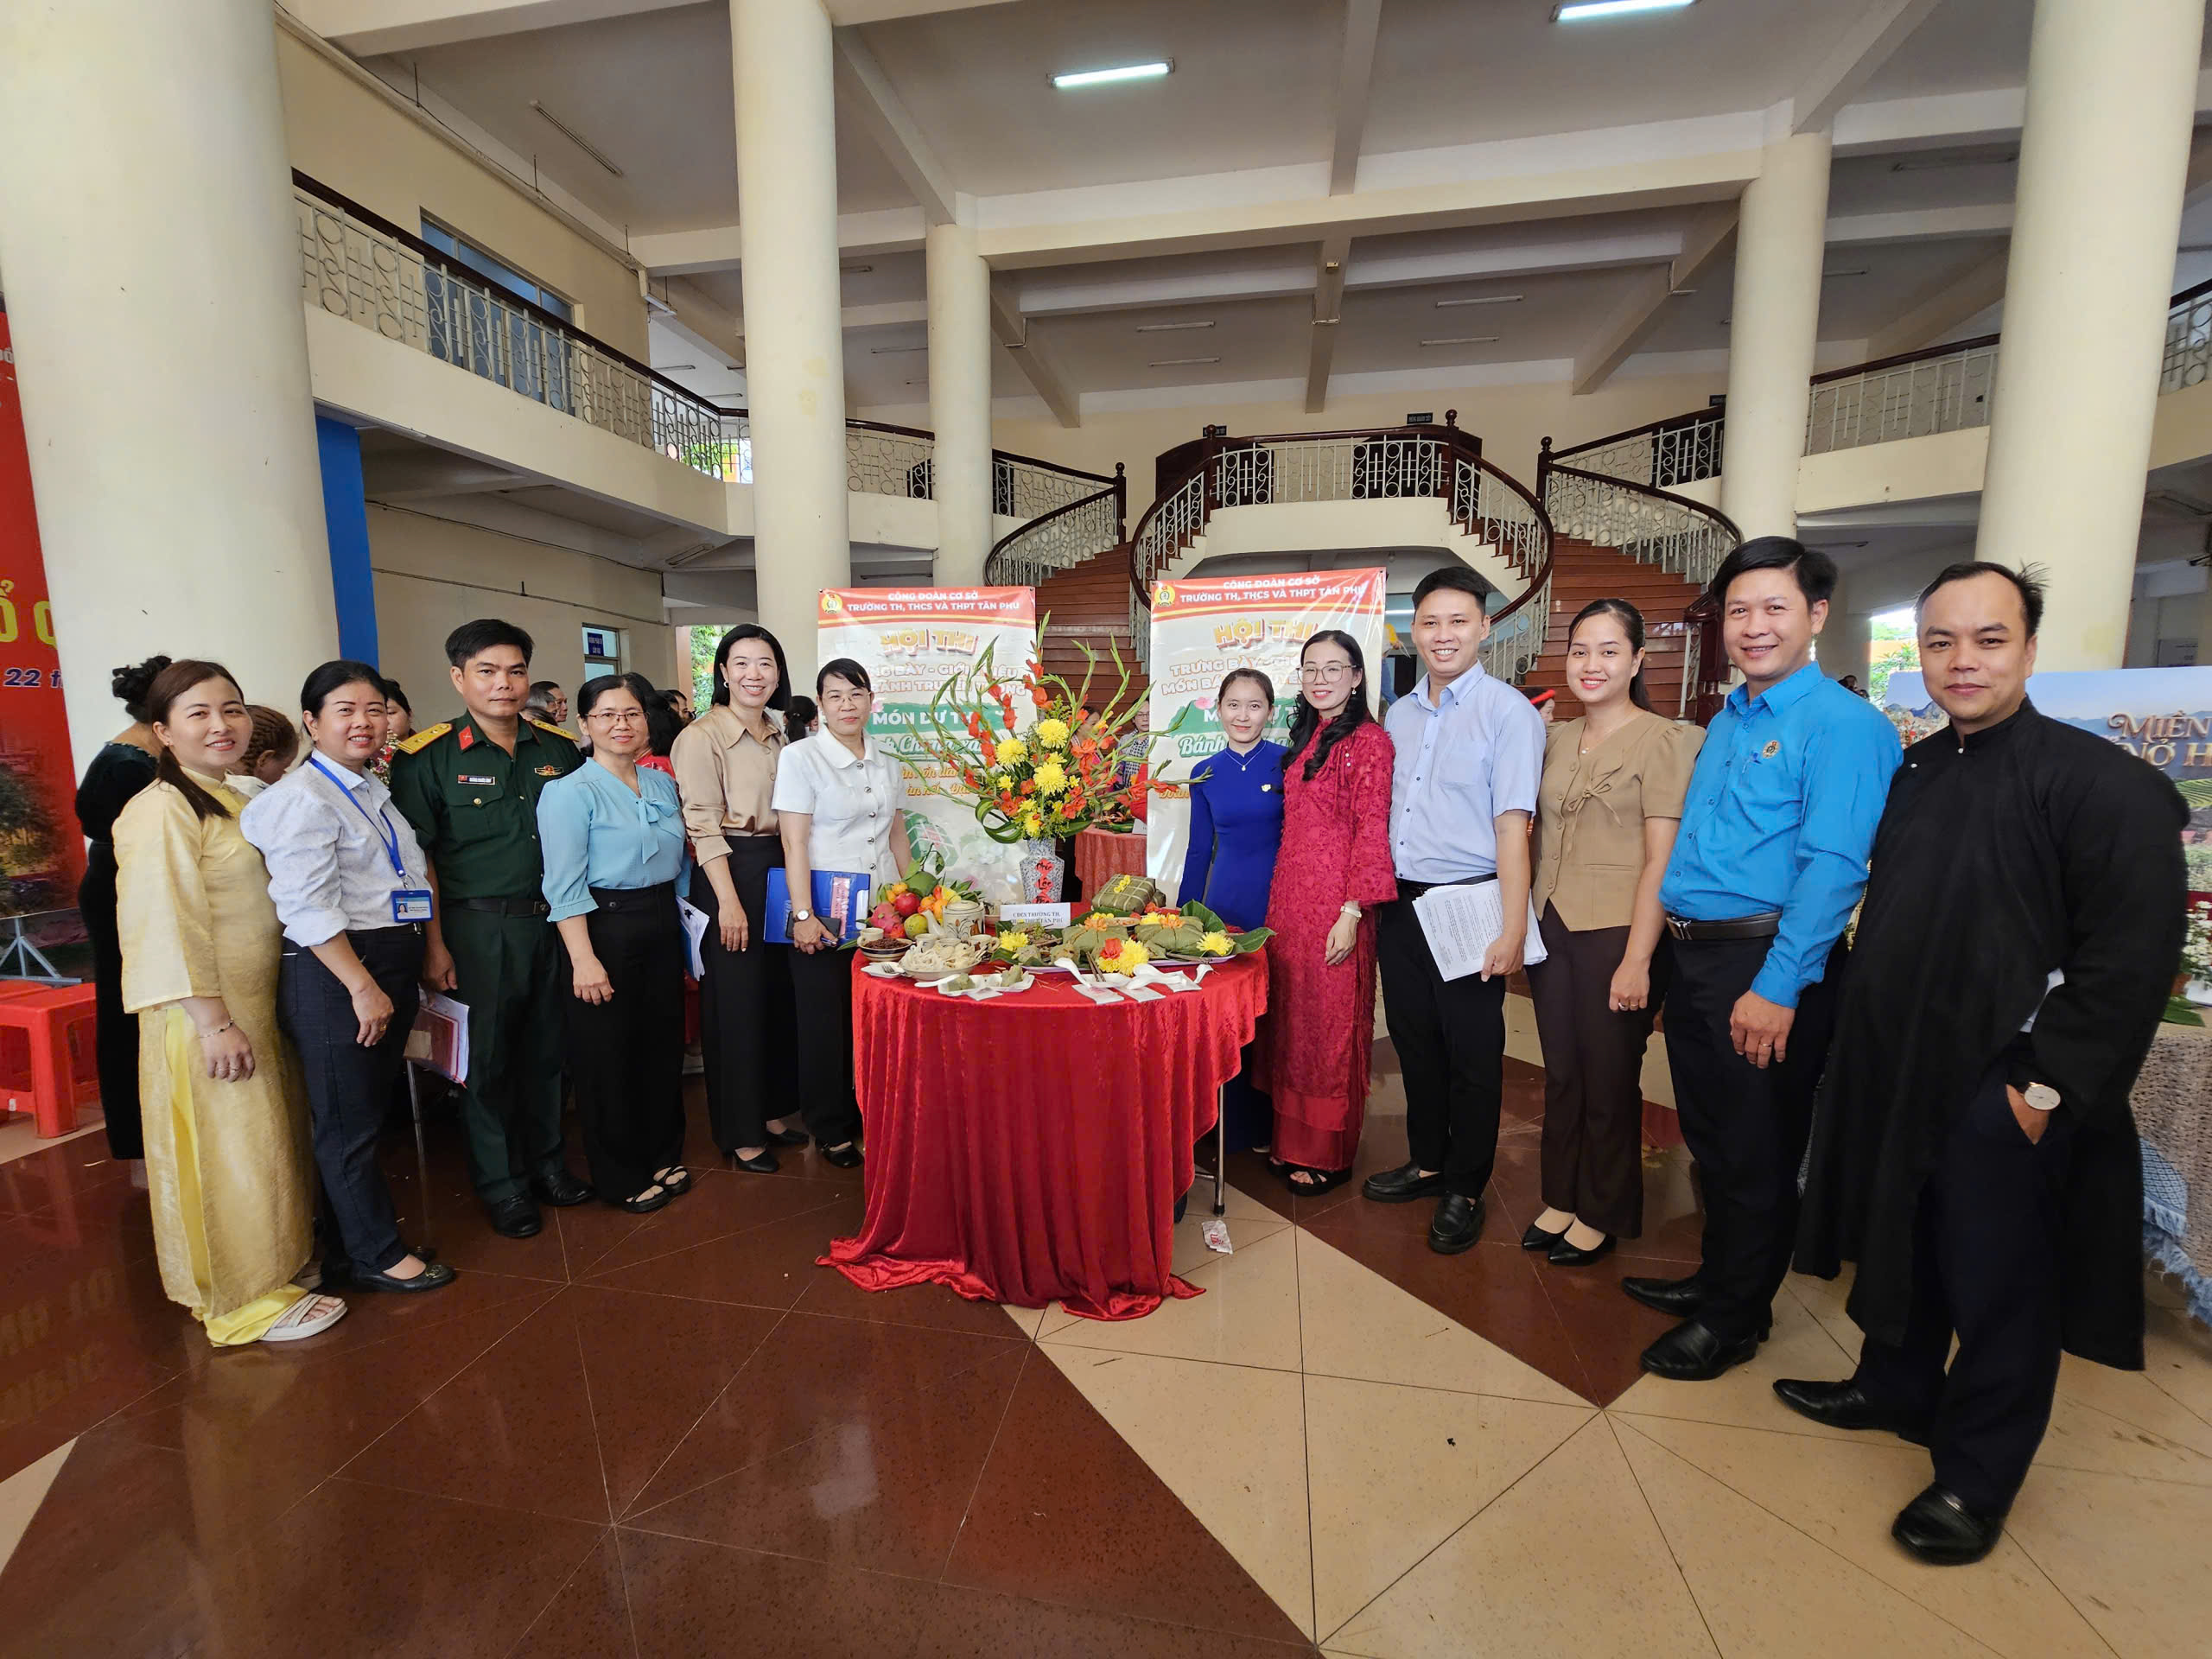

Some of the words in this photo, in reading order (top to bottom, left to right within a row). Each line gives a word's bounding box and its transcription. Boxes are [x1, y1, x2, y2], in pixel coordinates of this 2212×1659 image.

[1224, 580, 1252, 589] CÔNG
[1255, 577, 1286, 588] ĐOÀN
[887, 591, 917, 601] CÔNG
[918, 589, 947, 601] ĐOÀN
[1179, 592, 1223, 603] TRƯỜNG
[1224, 592, 1241, 602] TH,
[1243, 590, 1269, 601] THCS
[1272, 588, 1287, 599] VÀ
[1289, 588, 1317, 598] THPT
[1319, 585, 1341, 596] TÂN
[848, 601, 888, 612] TRƯỜNG
[890, 603, 906, 613] TH,
[907, 602, 933, 611] THCS
[935, 601, 949, 610] VÀ
[950, 602, 975, 611] THPT
[976, 601, 997, 610] TÂN
[932, 630, 978, 656] THI
[1214, 618, 1266, 650] HỘI
[894, 663, 926, 676] BÀY
[1170, 659, 1224, 677] TRƯNG
[3, 668, 41, 688] 22
[1161, 678, 1198, 696] MÓN
[873, 709, 915, 726] MÓN
[2108, 709, 2212, 743] MIỀN
